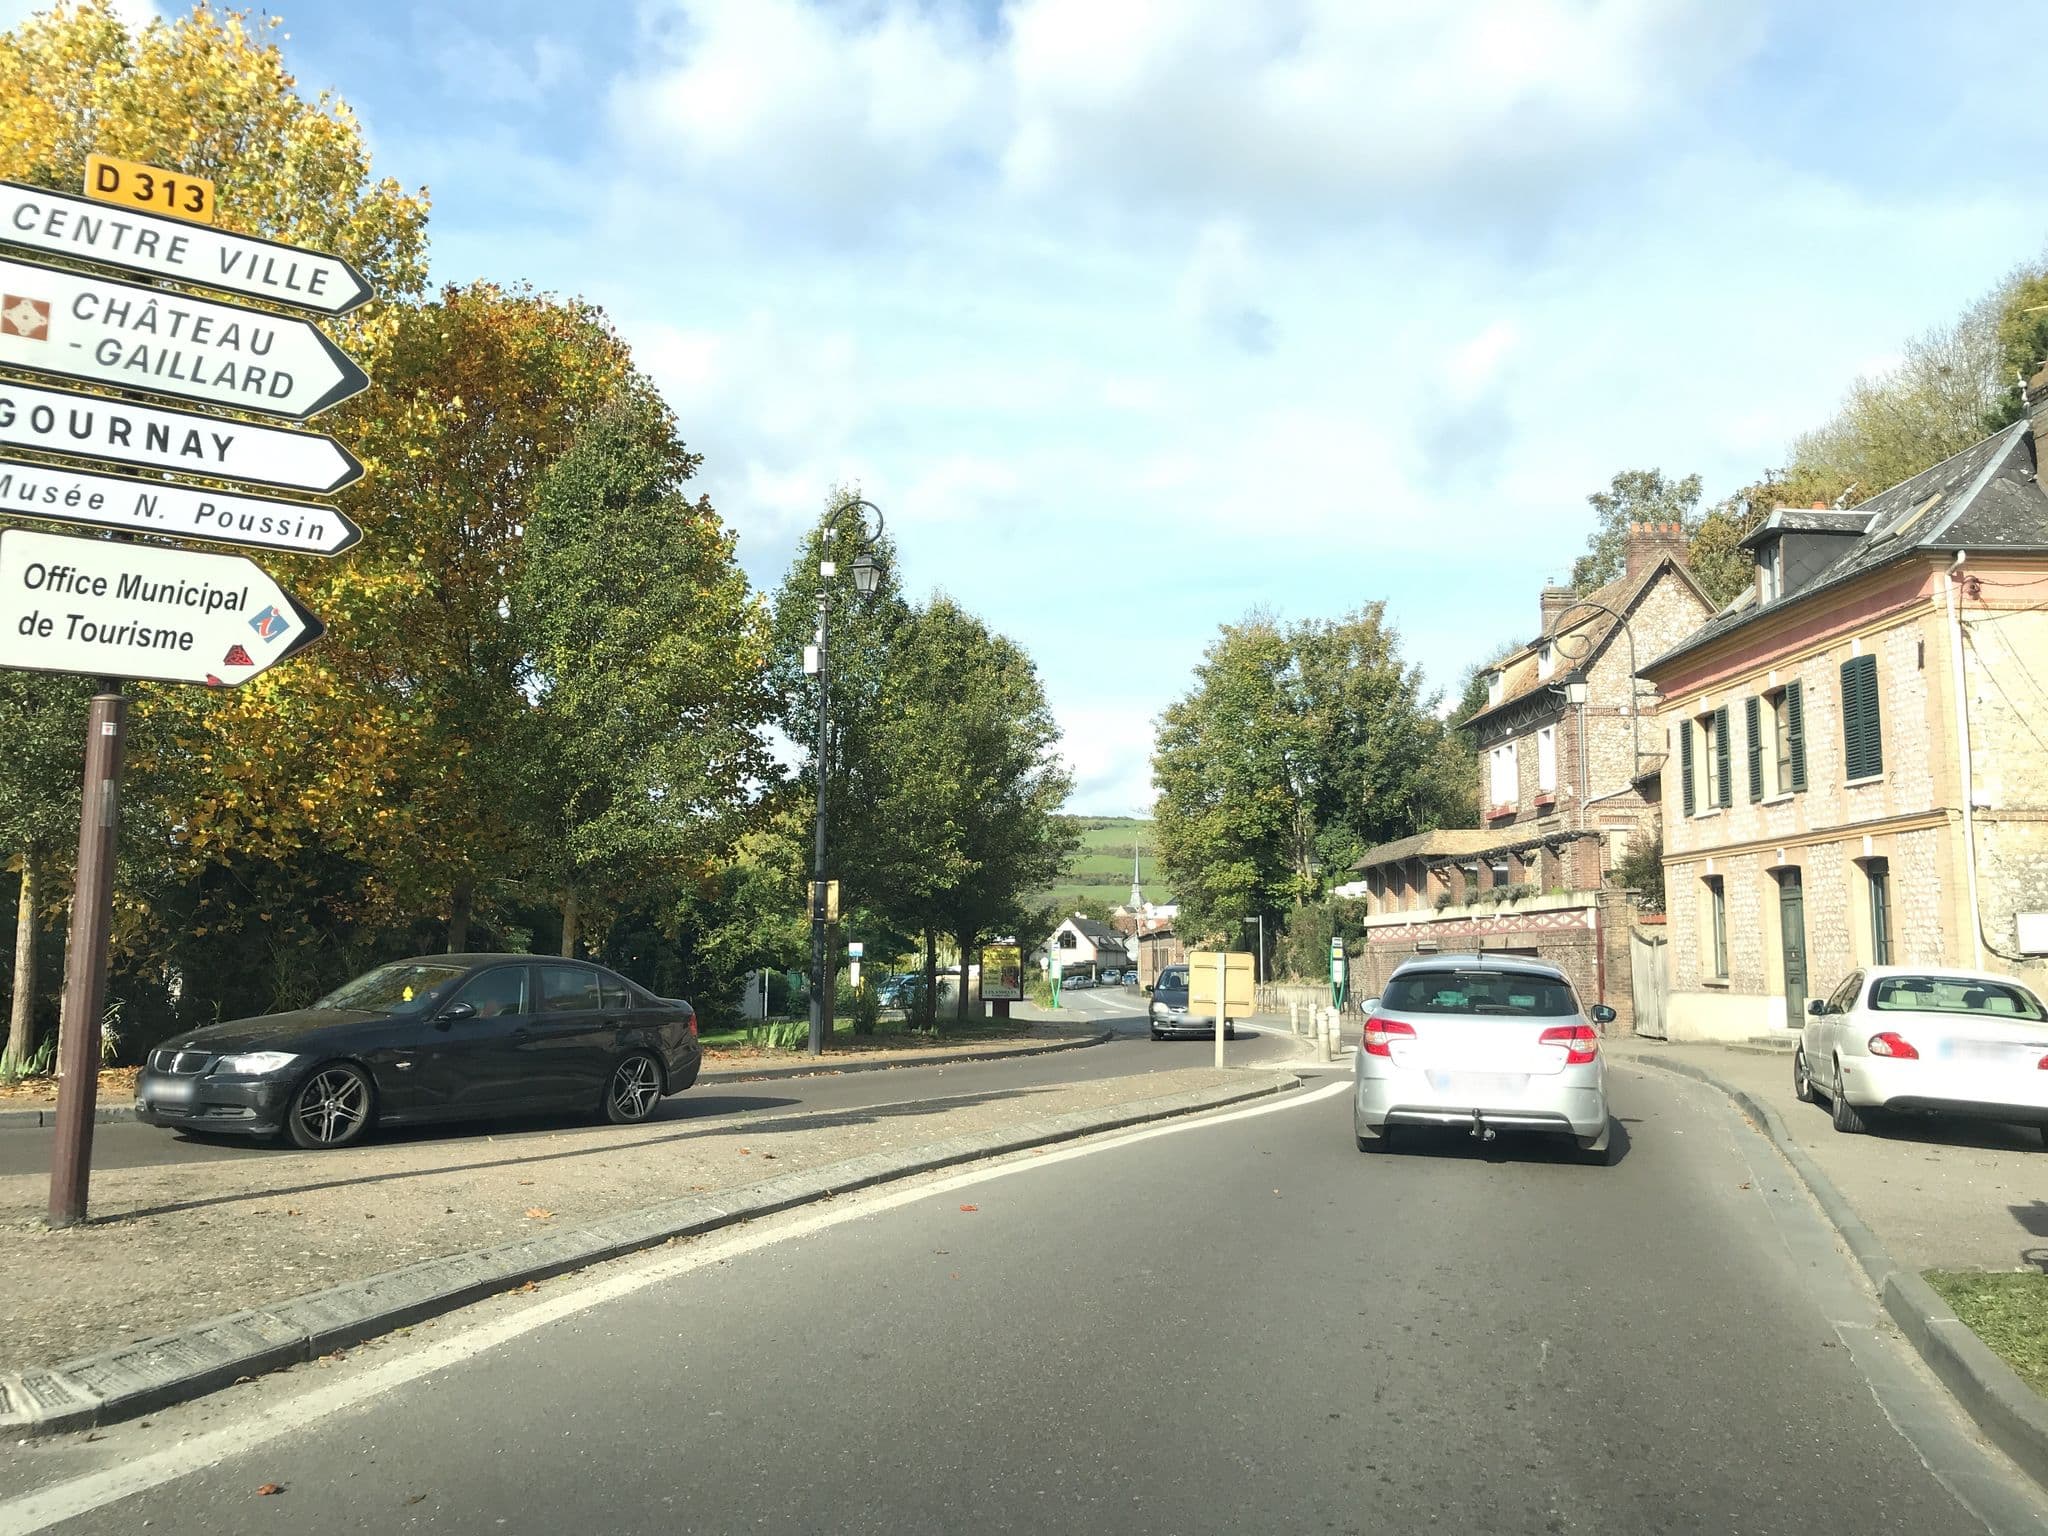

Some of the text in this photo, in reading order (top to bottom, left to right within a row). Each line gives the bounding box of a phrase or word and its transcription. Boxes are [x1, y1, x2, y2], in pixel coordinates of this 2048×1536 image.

[95, 165, 205, 214] D 313
[12, 203, 329, 296] CENTRE VILLE
[71, 292, 275, 356] CHÂTEAU
[0, 397, 235, 462] GOURNAY
[134, 493, 165, 520] N.
[195, 502, 324, 541] Poussin
[24, 563, 249, 614] Office Municipal
[18, 610, 194, 651] de Tourisme
